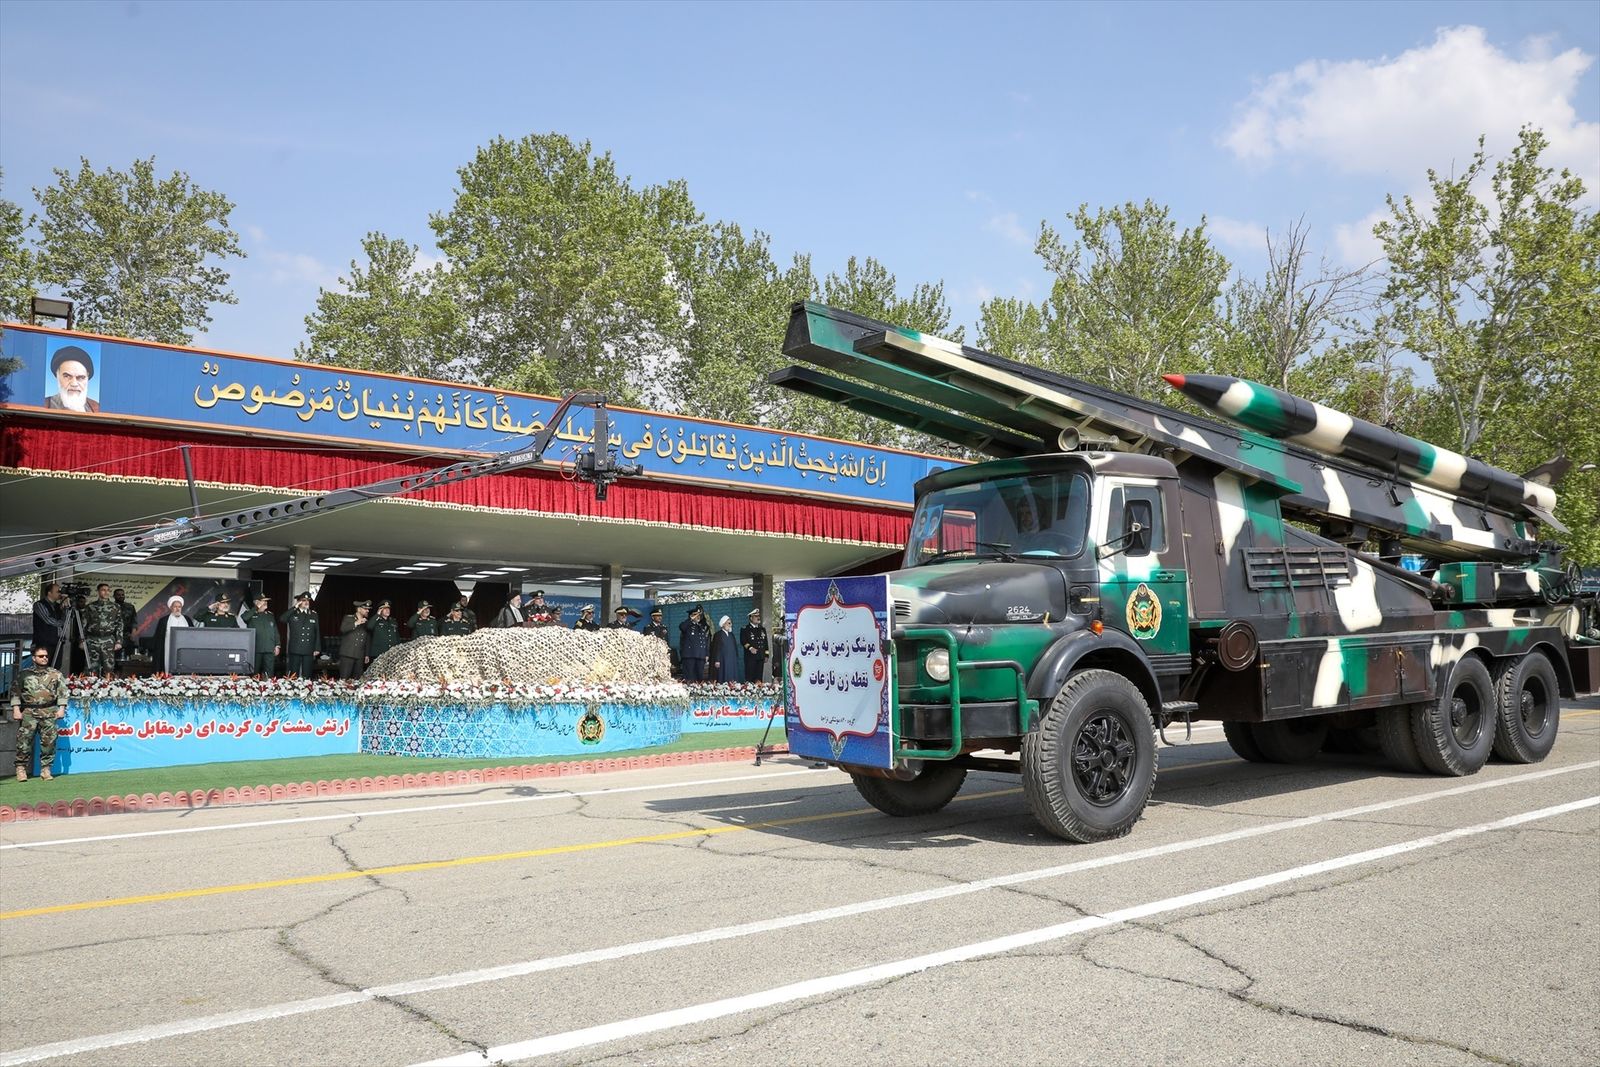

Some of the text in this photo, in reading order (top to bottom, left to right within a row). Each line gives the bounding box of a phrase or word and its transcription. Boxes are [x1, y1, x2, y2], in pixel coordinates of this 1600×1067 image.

[1007, 605, 1030, 614] 2624
[800, 636, 876, 659] موشک زمین به زمین
[809, 669, 869, 692] نقطه زن نازعات
[693, 706, 714, 718] است
[715, 705, 758, 719] استحکام
[57, 721, 81, 736] اس
[83, 722, 134, 740] متجاوز
[196, 720, 215, 738] ای
[218, 719, 253, 738] کرده
[282, 719, 313, 734] مشت
[316, 719, 349, 736] ارتش
